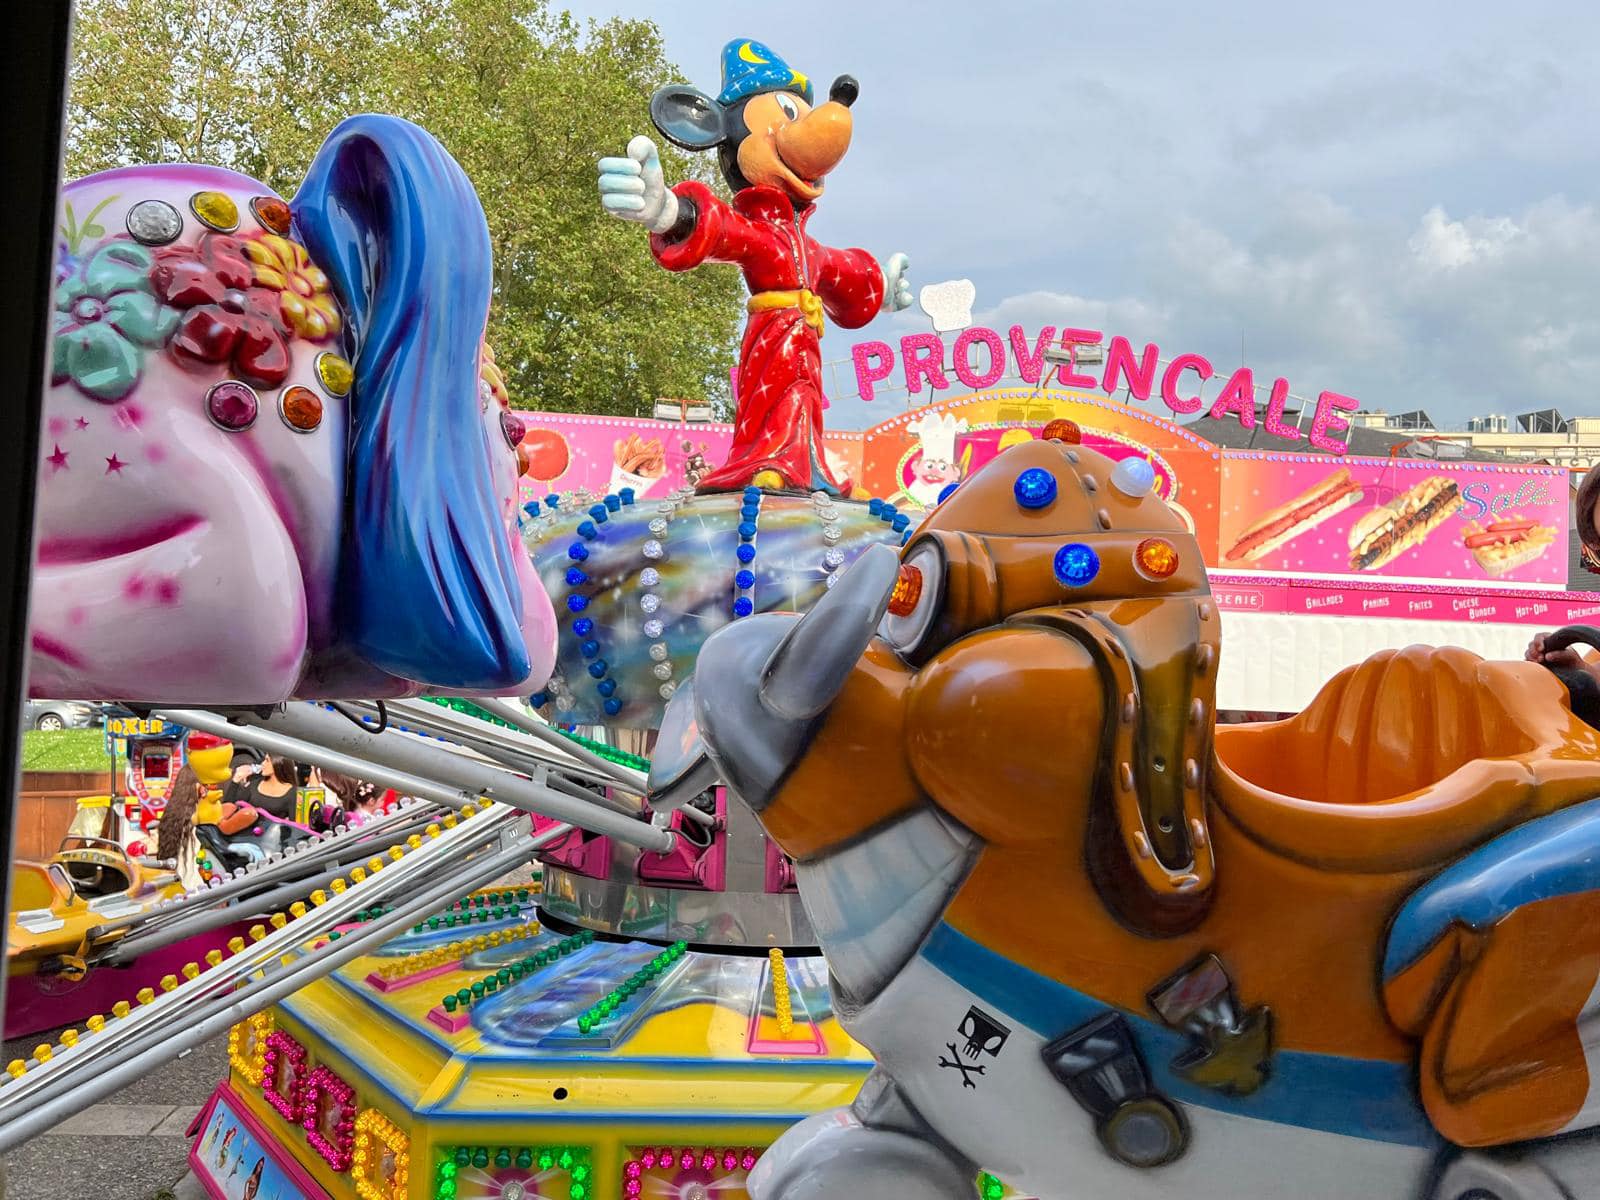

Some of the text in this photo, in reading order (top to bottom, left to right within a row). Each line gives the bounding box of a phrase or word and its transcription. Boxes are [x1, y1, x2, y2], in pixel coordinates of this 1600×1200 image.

[851, 324, 1360, 454] PROVENCALE
[1456, 479, 1560, 520] Salé
[1215, 593, 1257, 605] SERIE
